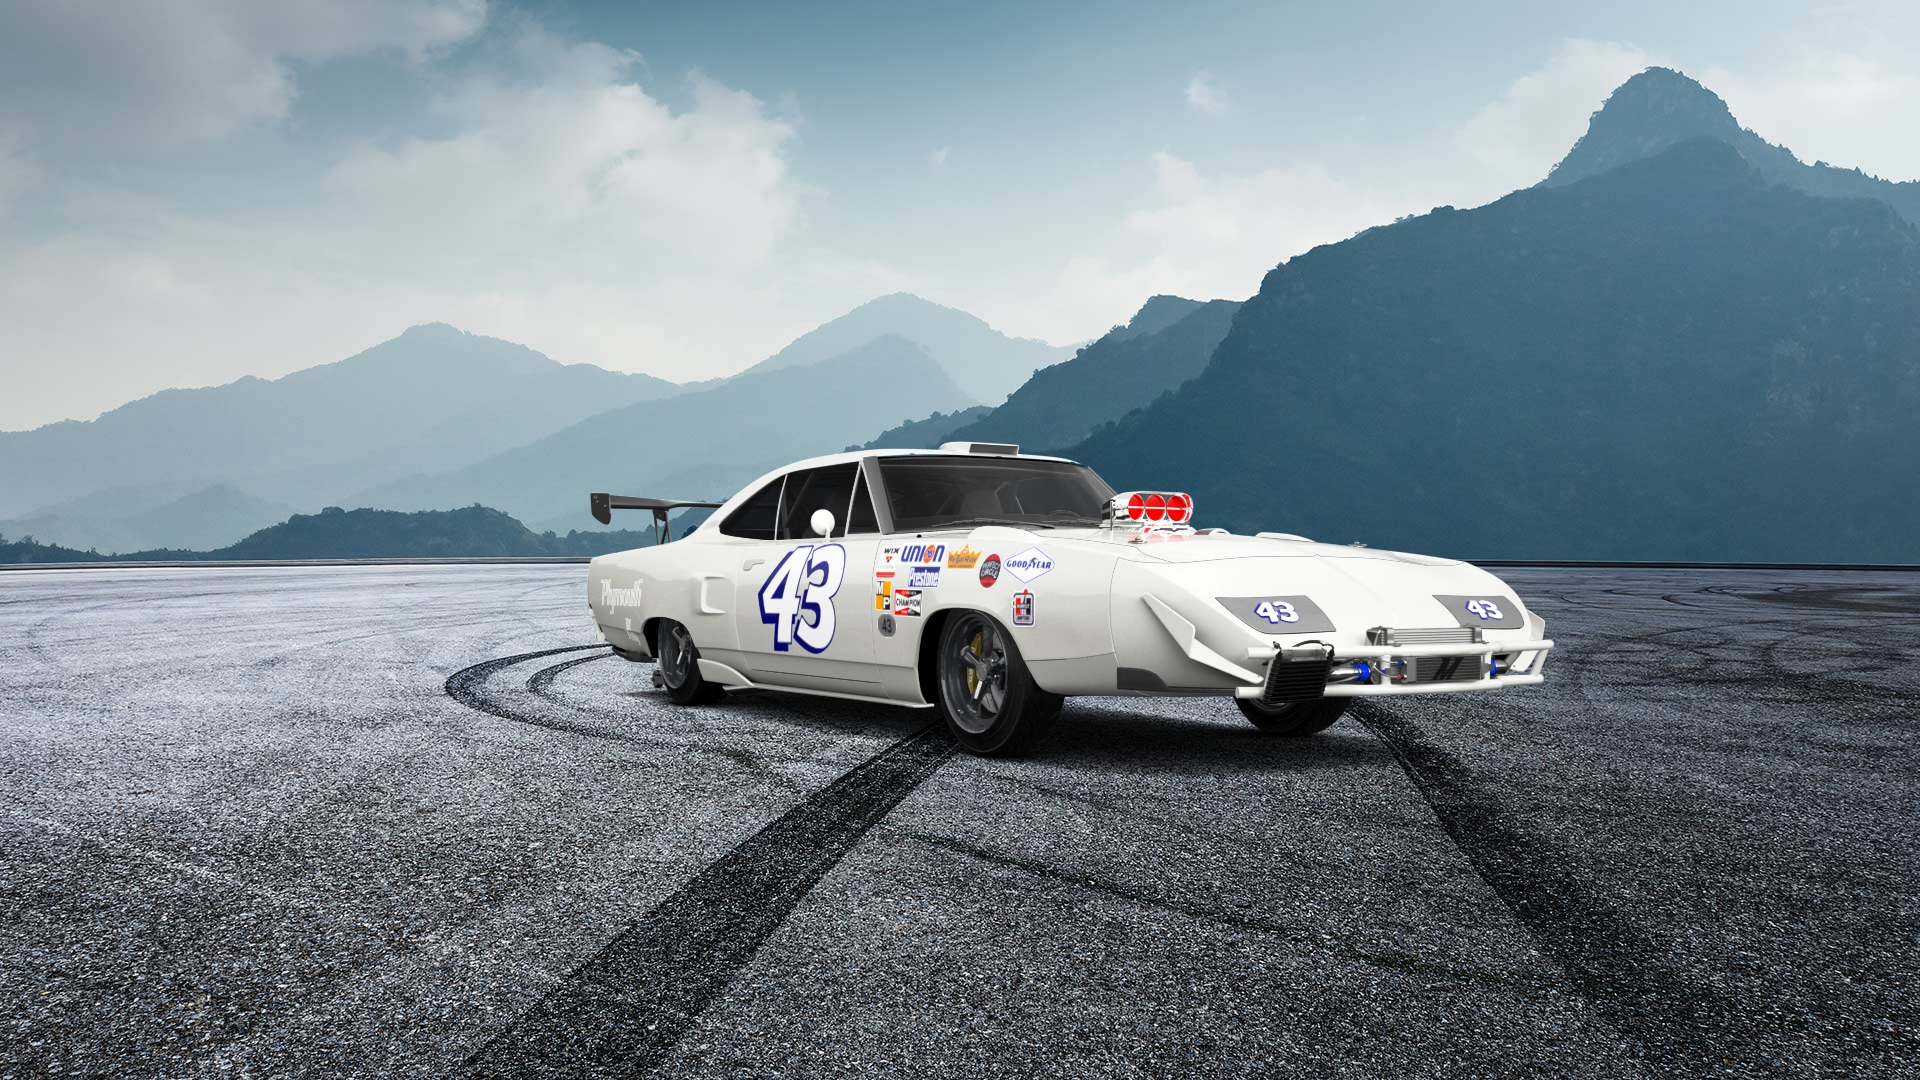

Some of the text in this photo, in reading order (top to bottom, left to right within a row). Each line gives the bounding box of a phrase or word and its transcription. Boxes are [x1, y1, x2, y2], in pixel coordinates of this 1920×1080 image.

[908, 567, 940, 587] Prestone
[601, 579, 643, 614] Plymouth
[758, 543, 846, 654] 43
[896, 598, 921, 607] CHAMPION
[1254, 601, 1300, 624] 43
[1466, 600, 1503, 620] 43
[882, 618, 892, 634] 43
